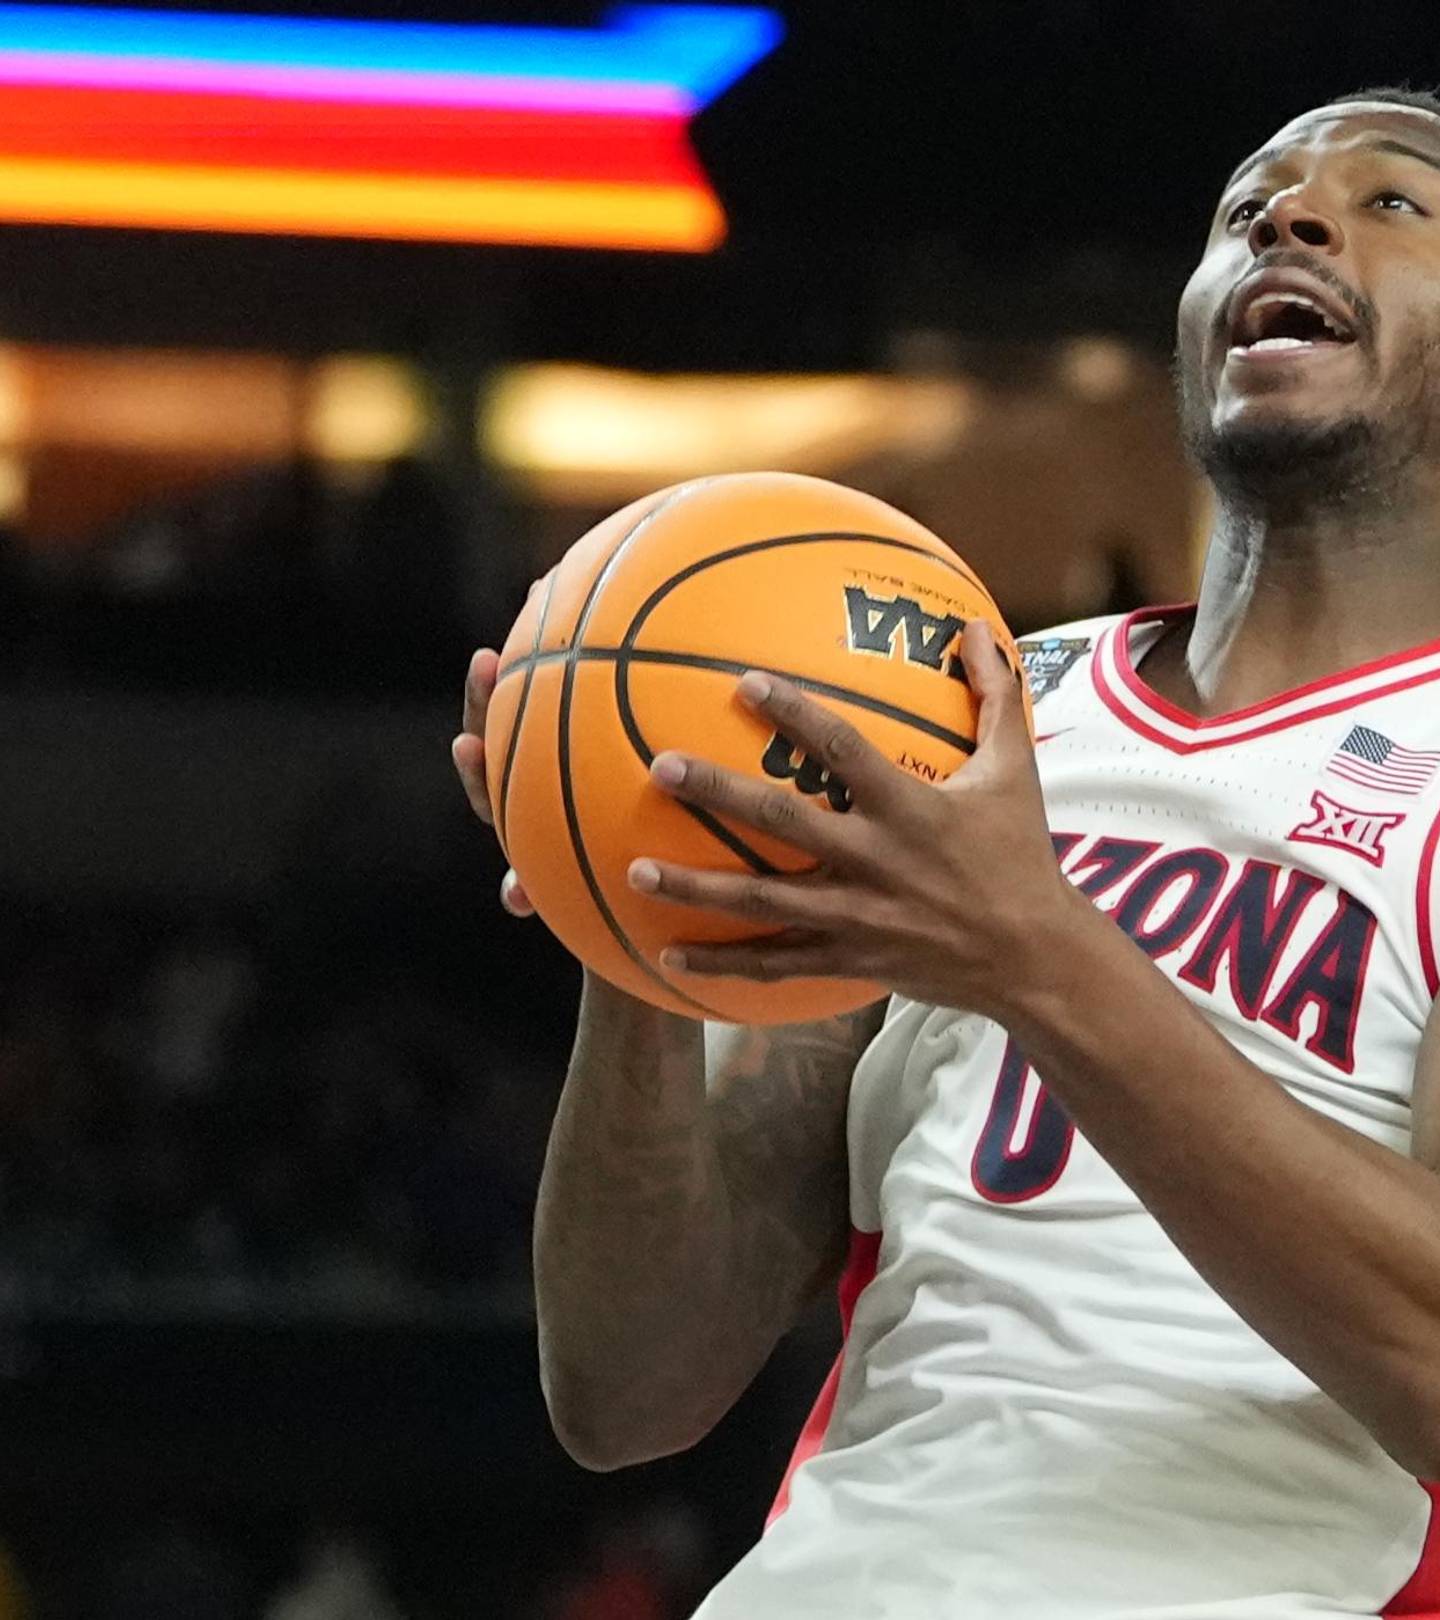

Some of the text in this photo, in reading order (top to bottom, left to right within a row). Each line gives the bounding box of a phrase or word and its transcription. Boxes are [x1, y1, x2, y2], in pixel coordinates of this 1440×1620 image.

[843, 583, 976, 678] AA
[1021, 649, 1072, 667] INAL
[897, 751, 938, 782] NXT
[1289, 791, 1405, 867] XII
[1050, 832, 1378, 1075] ZONA
